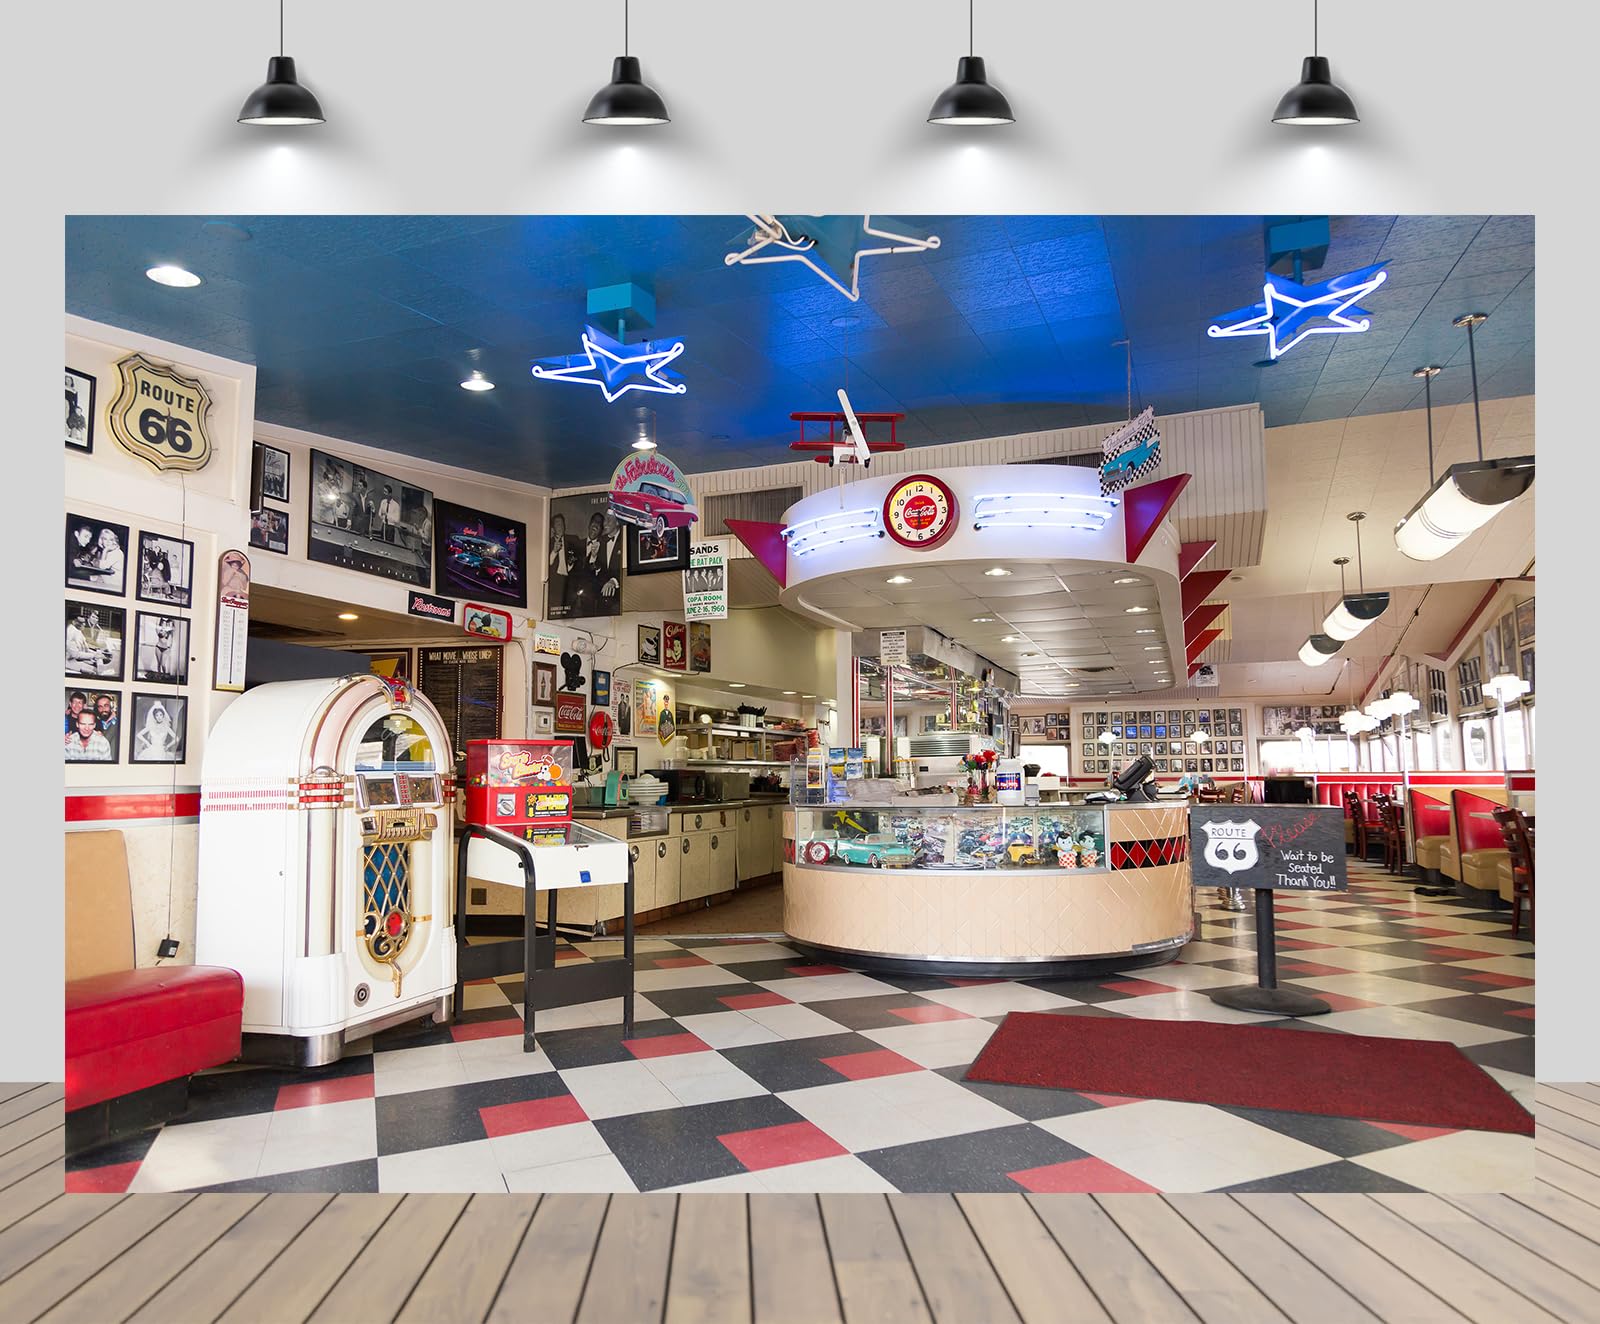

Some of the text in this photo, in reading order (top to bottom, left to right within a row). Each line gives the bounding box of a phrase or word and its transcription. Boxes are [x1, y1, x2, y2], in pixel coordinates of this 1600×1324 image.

[140, 379, 195, 414] ROUTE
[138, 407, 193, 453] 66
[918, 533, 923, 541] 6
[690, 545, 719, 555] SANDS
[697, 557, 708, 566] RAT
[708, 556, 723, 565] PACK
[411, 597, 451, 617] Restrooms
[711, 605, 725, 614] 1960
[428, 651, 442, 661] WHAT
[462, 650, 478, 660] WHOSE
[478, 650, 493, 660] LINE?
[558, 704, 583, 721] Coca-Cola
[1211, 827, 1247, 838] ROUTE
[1260, 812, 1317, 849] Please
[1214, 841, 1247, 861] 66
[1280, 849, 1335, 864] Wait to be
[1275, 873, 1309, 887] Thank
